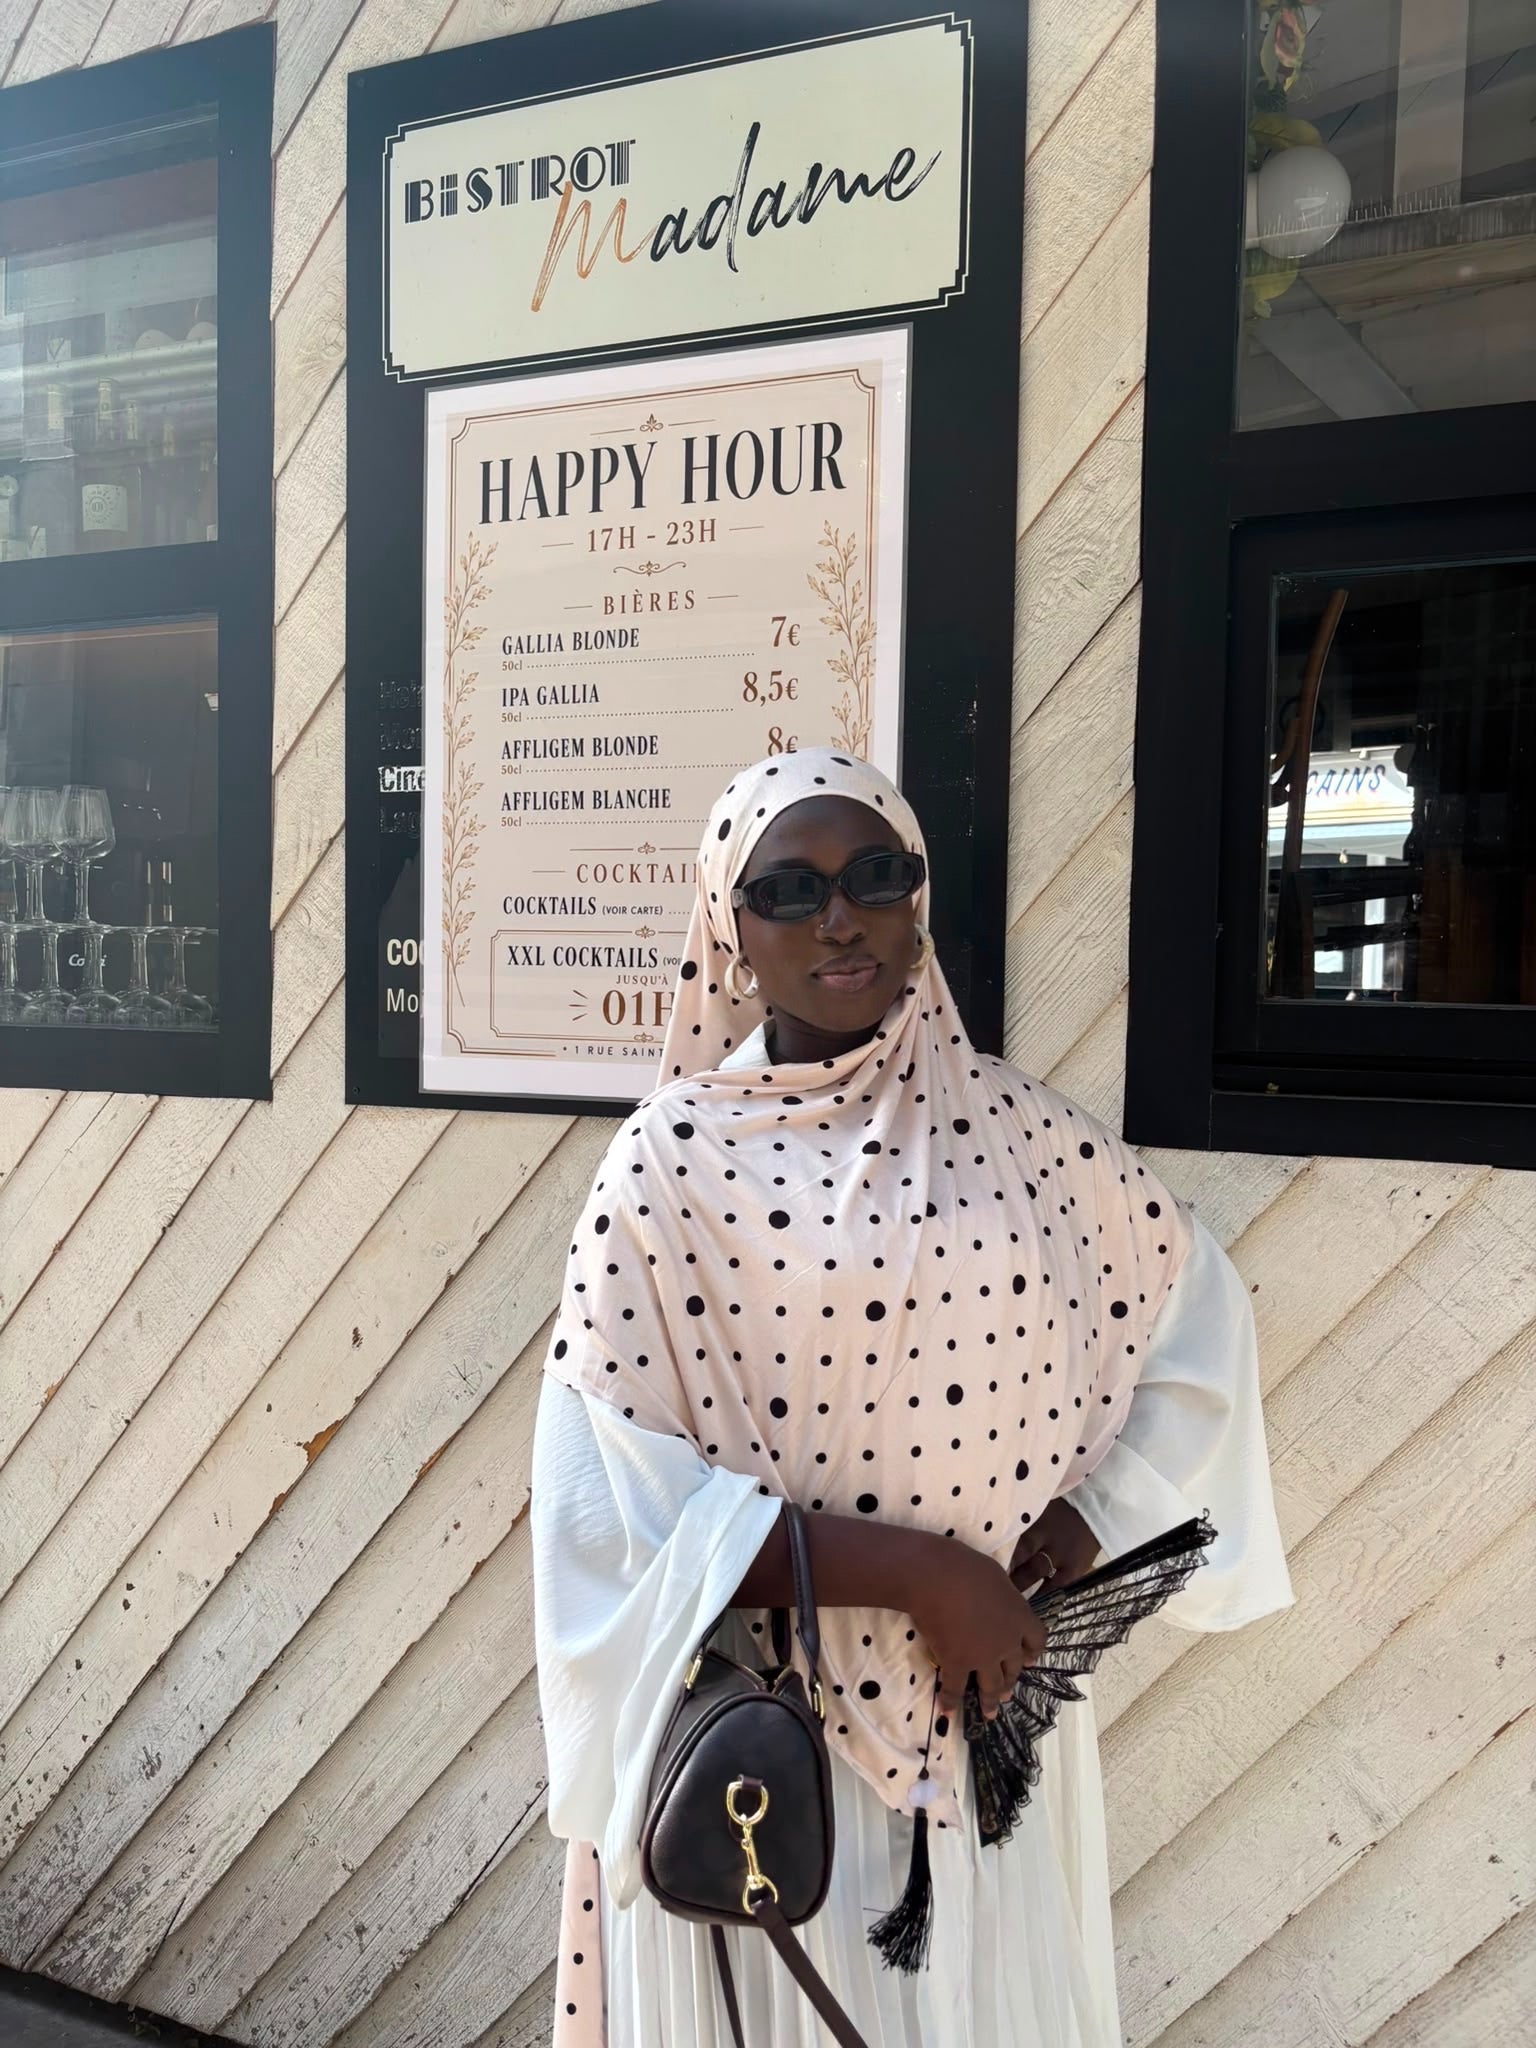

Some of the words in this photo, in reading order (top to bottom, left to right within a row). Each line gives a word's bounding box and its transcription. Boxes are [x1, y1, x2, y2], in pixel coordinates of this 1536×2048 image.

[531, 121, 942, 312] Madame
[479, 441, 658, 524] HAPPY
[680, 420, 847, 504] HOUR
[589, 526, 635, 552] 17H
[666, 519, 716, 545] 23H
[604, 589, 694, 615] BIÈRES
[502, 633, 564, 655] GALLIA
[573, 628, 639, 651] BLONDE
[772, 616, 800, 647] 7€
[501, 659, 523, 672] 50cl
[502, 687, 529, 707] IPA
[537, 684, 600, 705] GALLIA
[743, 670, 798, 707] 8,5€
[501, 711, 522, 723] 50cl
[501, 738, 584, 760] AFFLIGEM
[592, 735, 658, 757] BLONDE
[767, 726, 799, 757] 8€
[501, 763, 522, 775] 50cl
[501, 791, 584, 811] AFFLIGEM
[593, 788, 671, 809] BLANCHE
[500, 815, 522, 828] 50cl
[503, 896, 596, 915] COCKTAILS
[601, 904, 628, 916] (VOIR
[630, 905, 664, 916] CARTE)
[508, 946, 545, 966] XXL
[553, 946, 657, 968] COCKTAILS
[615, 972, 669, 987] JUSQU'À
[574, 1045, 579, 1055] 1
[587, 1045, 614, 1056] RUE
[622, 1046, 664, 1059] SAINT
